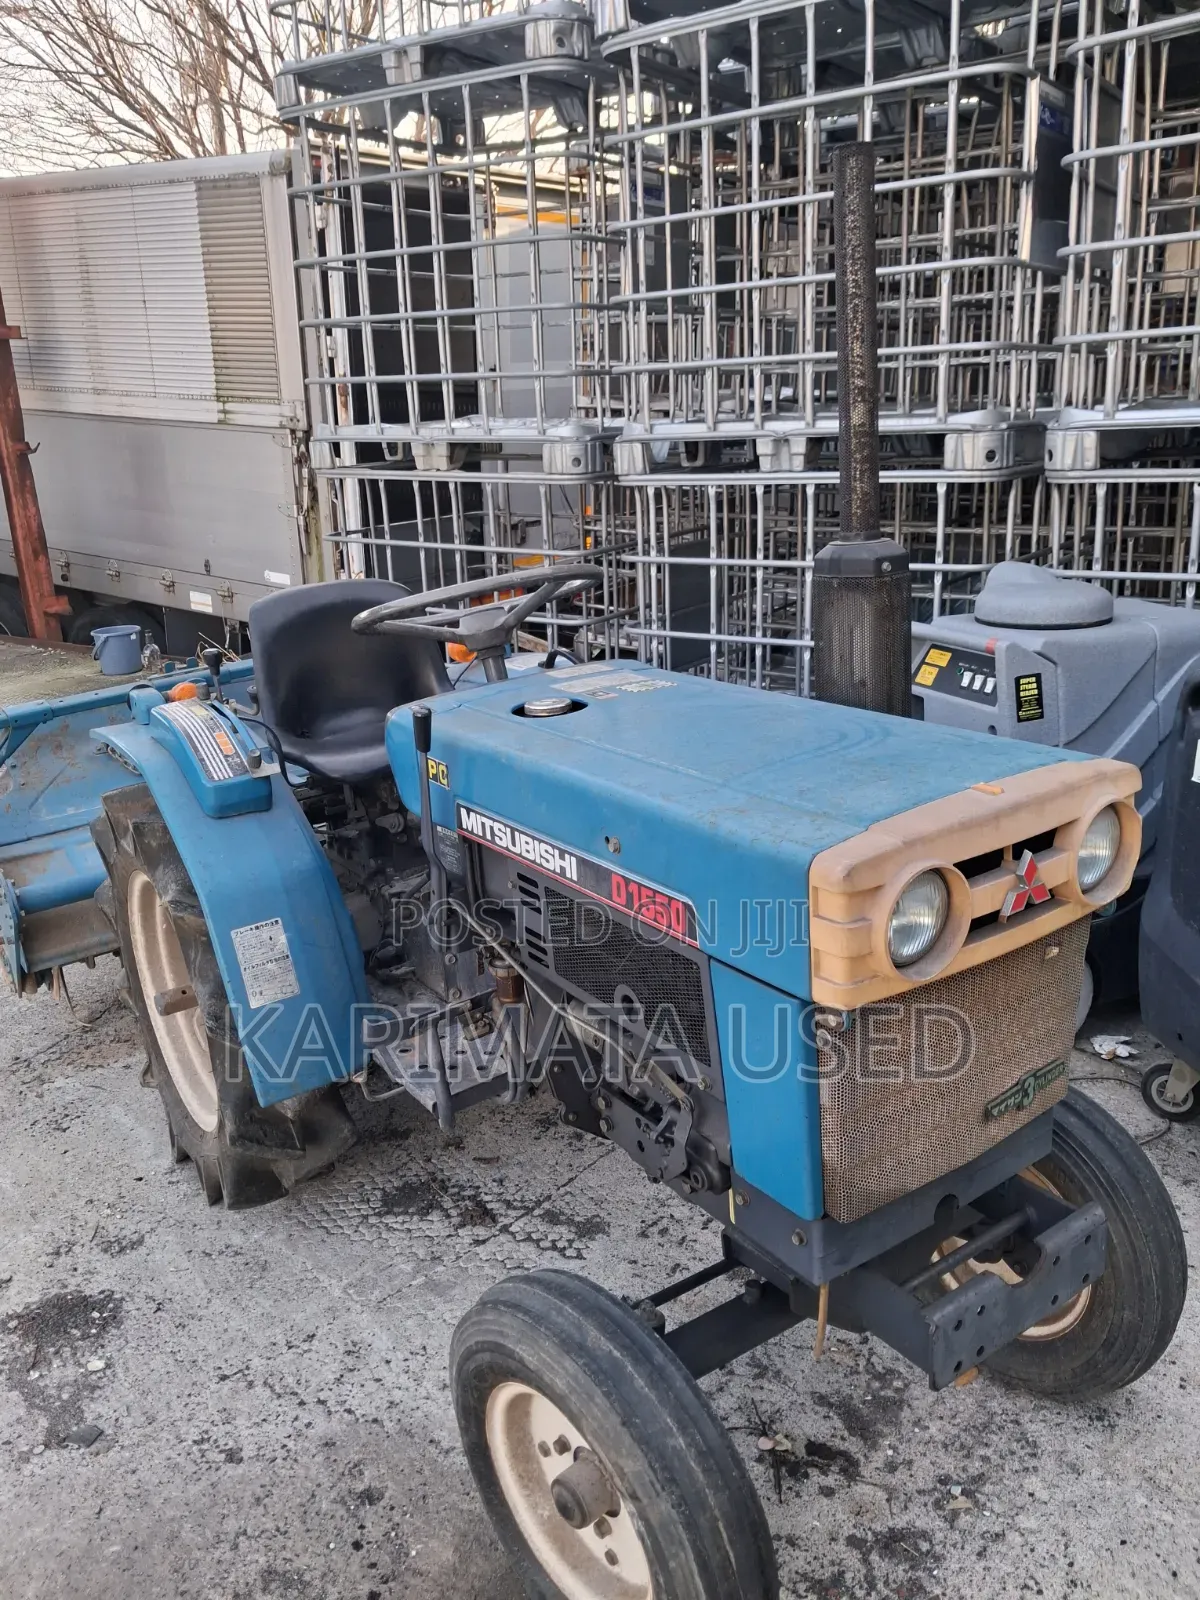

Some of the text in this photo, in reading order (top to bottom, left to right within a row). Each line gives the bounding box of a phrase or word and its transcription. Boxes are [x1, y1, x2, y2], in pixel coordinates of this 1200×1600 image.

[460, 808, 578, 881] MITSUBISHI
[612, 873, 685, 935] D1550
[1022, 1076, 1035, 1106] 3
